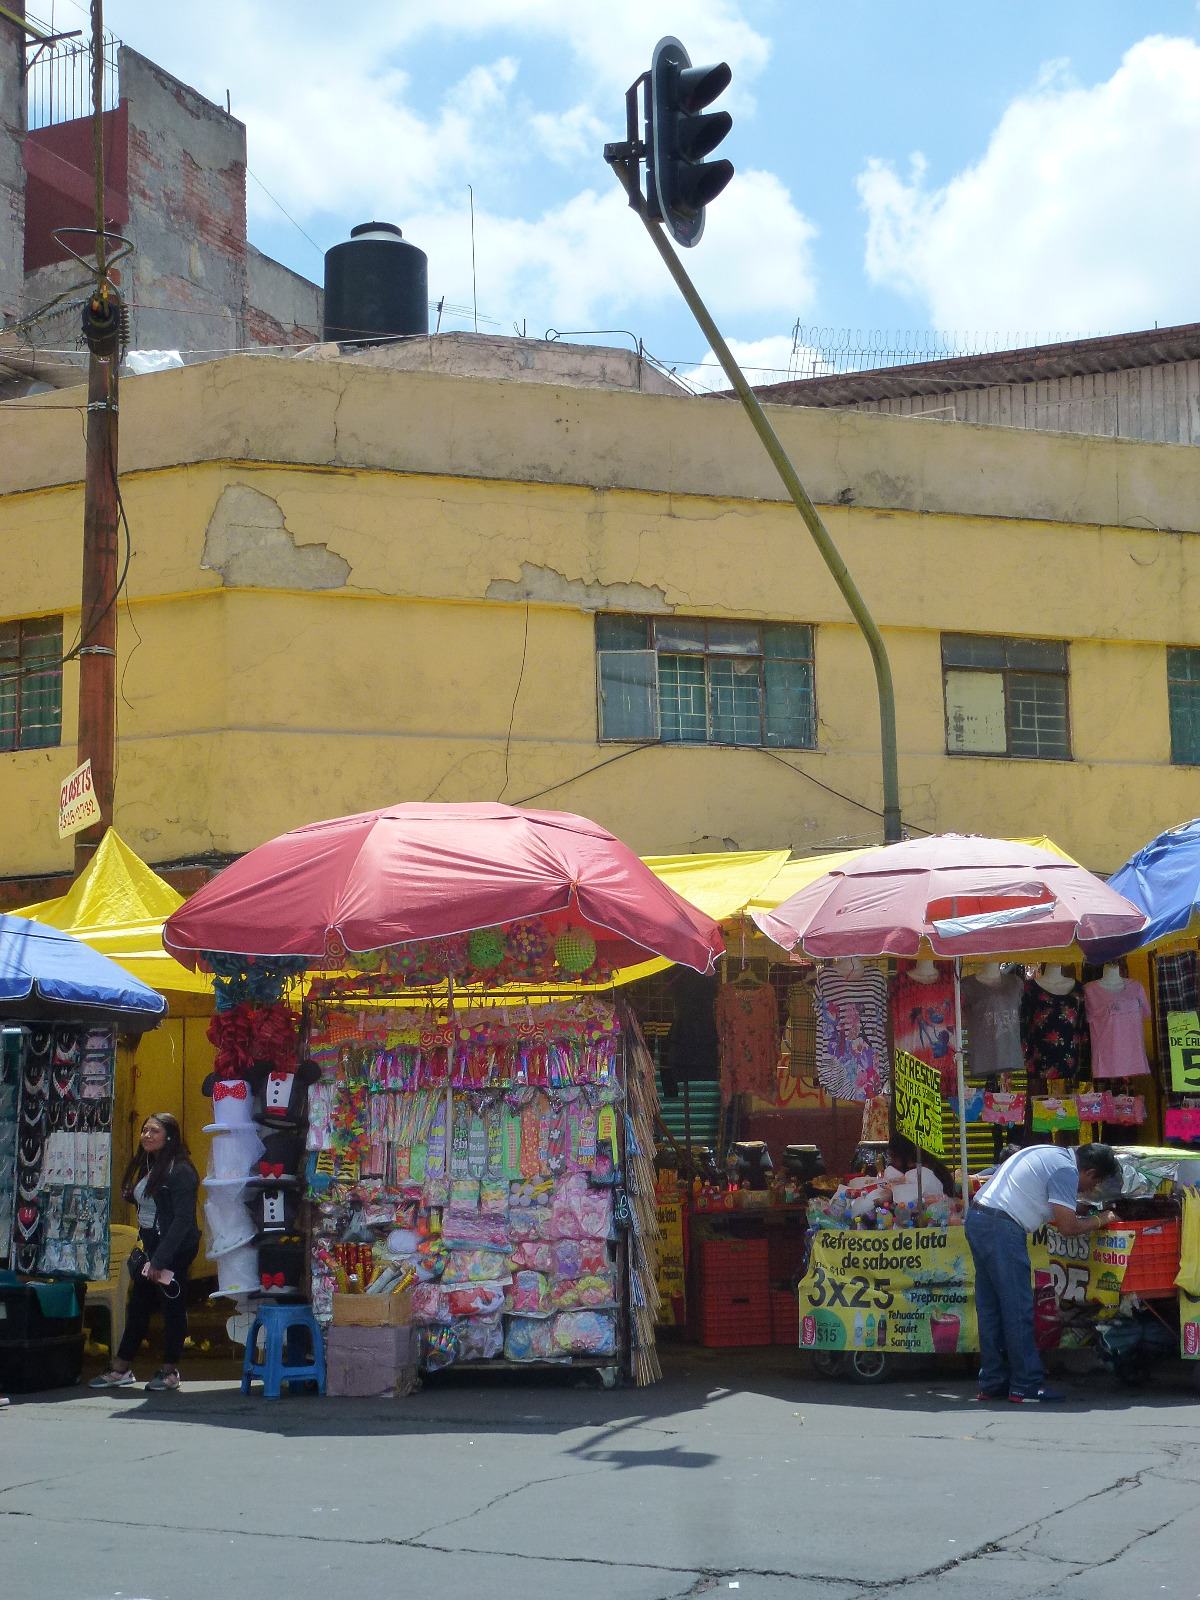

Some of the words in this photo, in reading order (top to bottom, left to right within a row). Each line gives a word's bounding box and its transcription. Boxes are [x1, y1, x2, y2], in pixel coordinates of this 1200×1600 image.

[60, 764, 92, 808] CLOSETS
[1171, 1037, 1182, 1046] DE
[895, 1048, 941, 1094] REFRESCOS
[822, 1232, 889, 1251] Refrescos
[892, 1232, 912, 1250] de
[915, 1232, 947, 1249] lata
[842, 1252, 859, 1268] de
[862, 1254, 921, 1270] sabores
[807, 1268, 894, 1309] 3x25
[910, 1292, 968, 1305] Preparados
[817, 1328, 837, 1342] $15
[894, 1323, 918, 1335] Squirt
